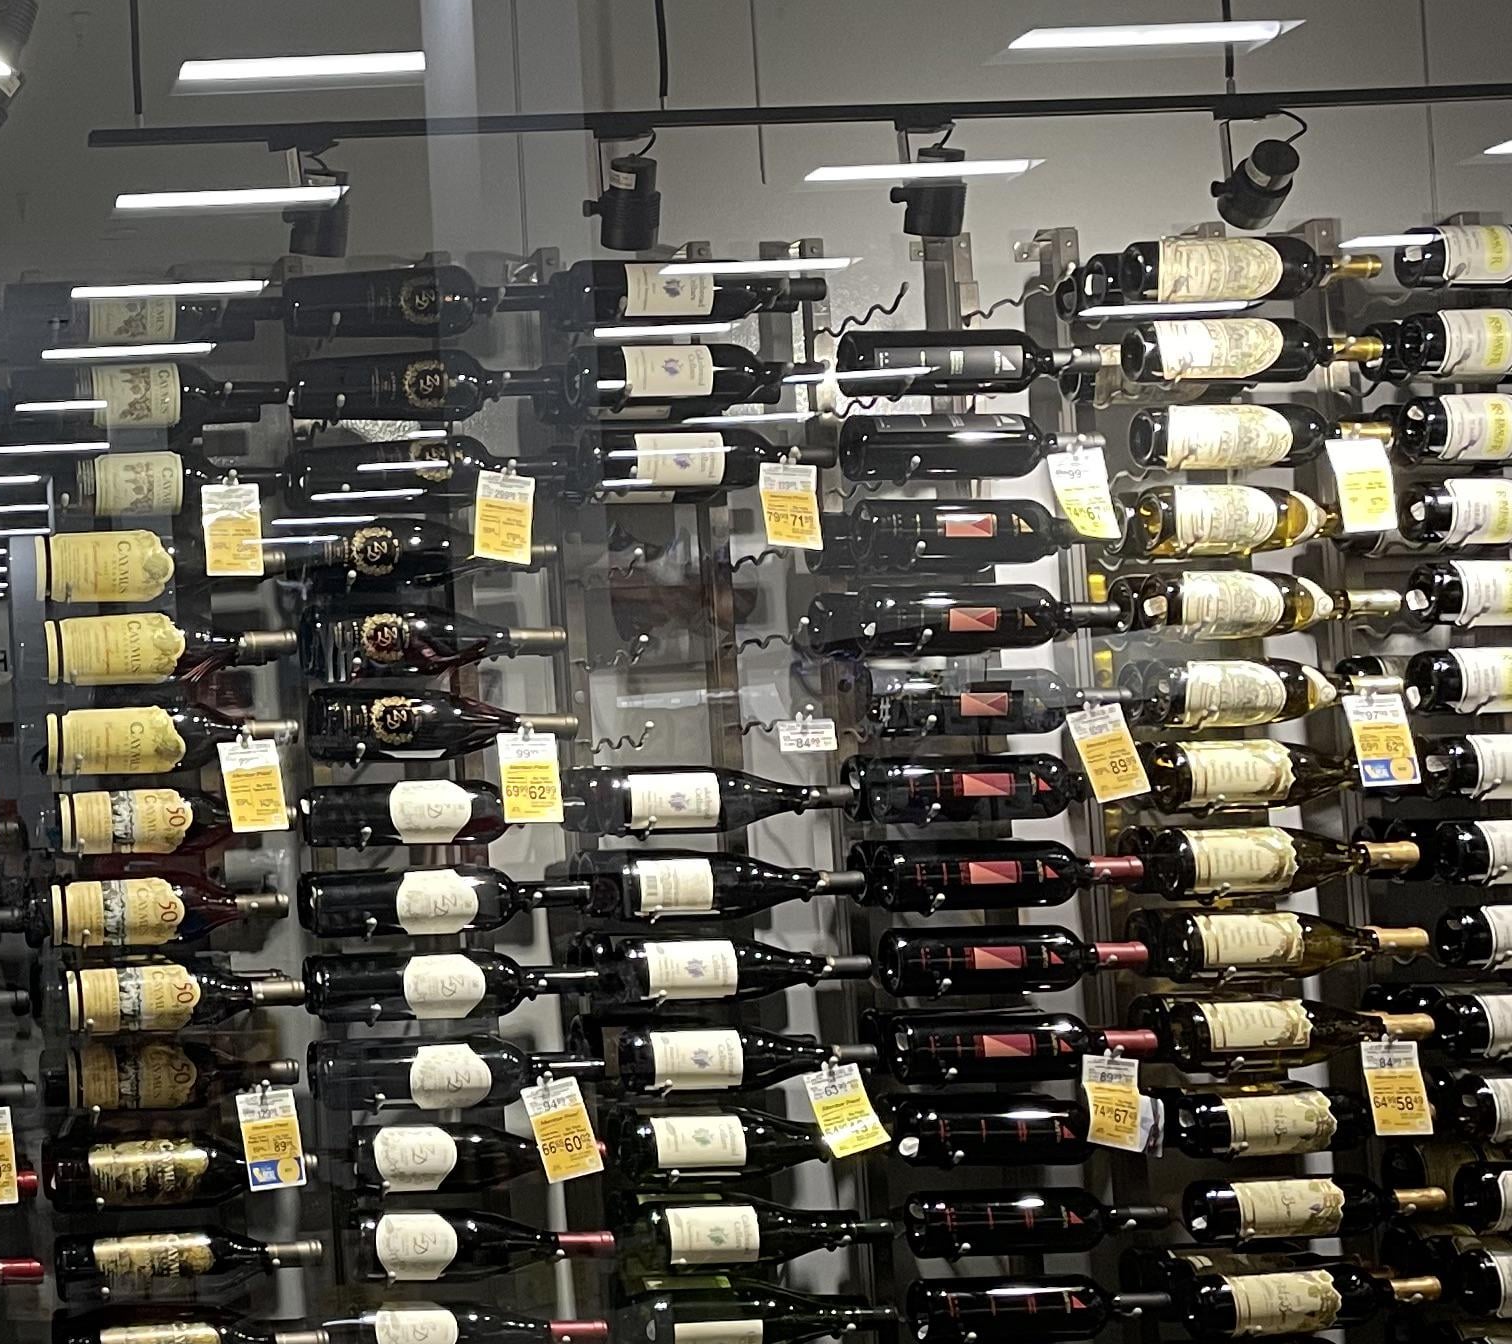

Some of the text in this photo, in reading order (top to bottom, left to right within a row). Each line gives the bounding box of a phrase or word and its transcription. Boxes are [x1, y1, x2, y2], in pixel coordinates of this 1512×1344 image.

[166, 805, 187, 828] 50
[157, 899, 178, 923] 50
[176, 981, 195, 1005] 50
